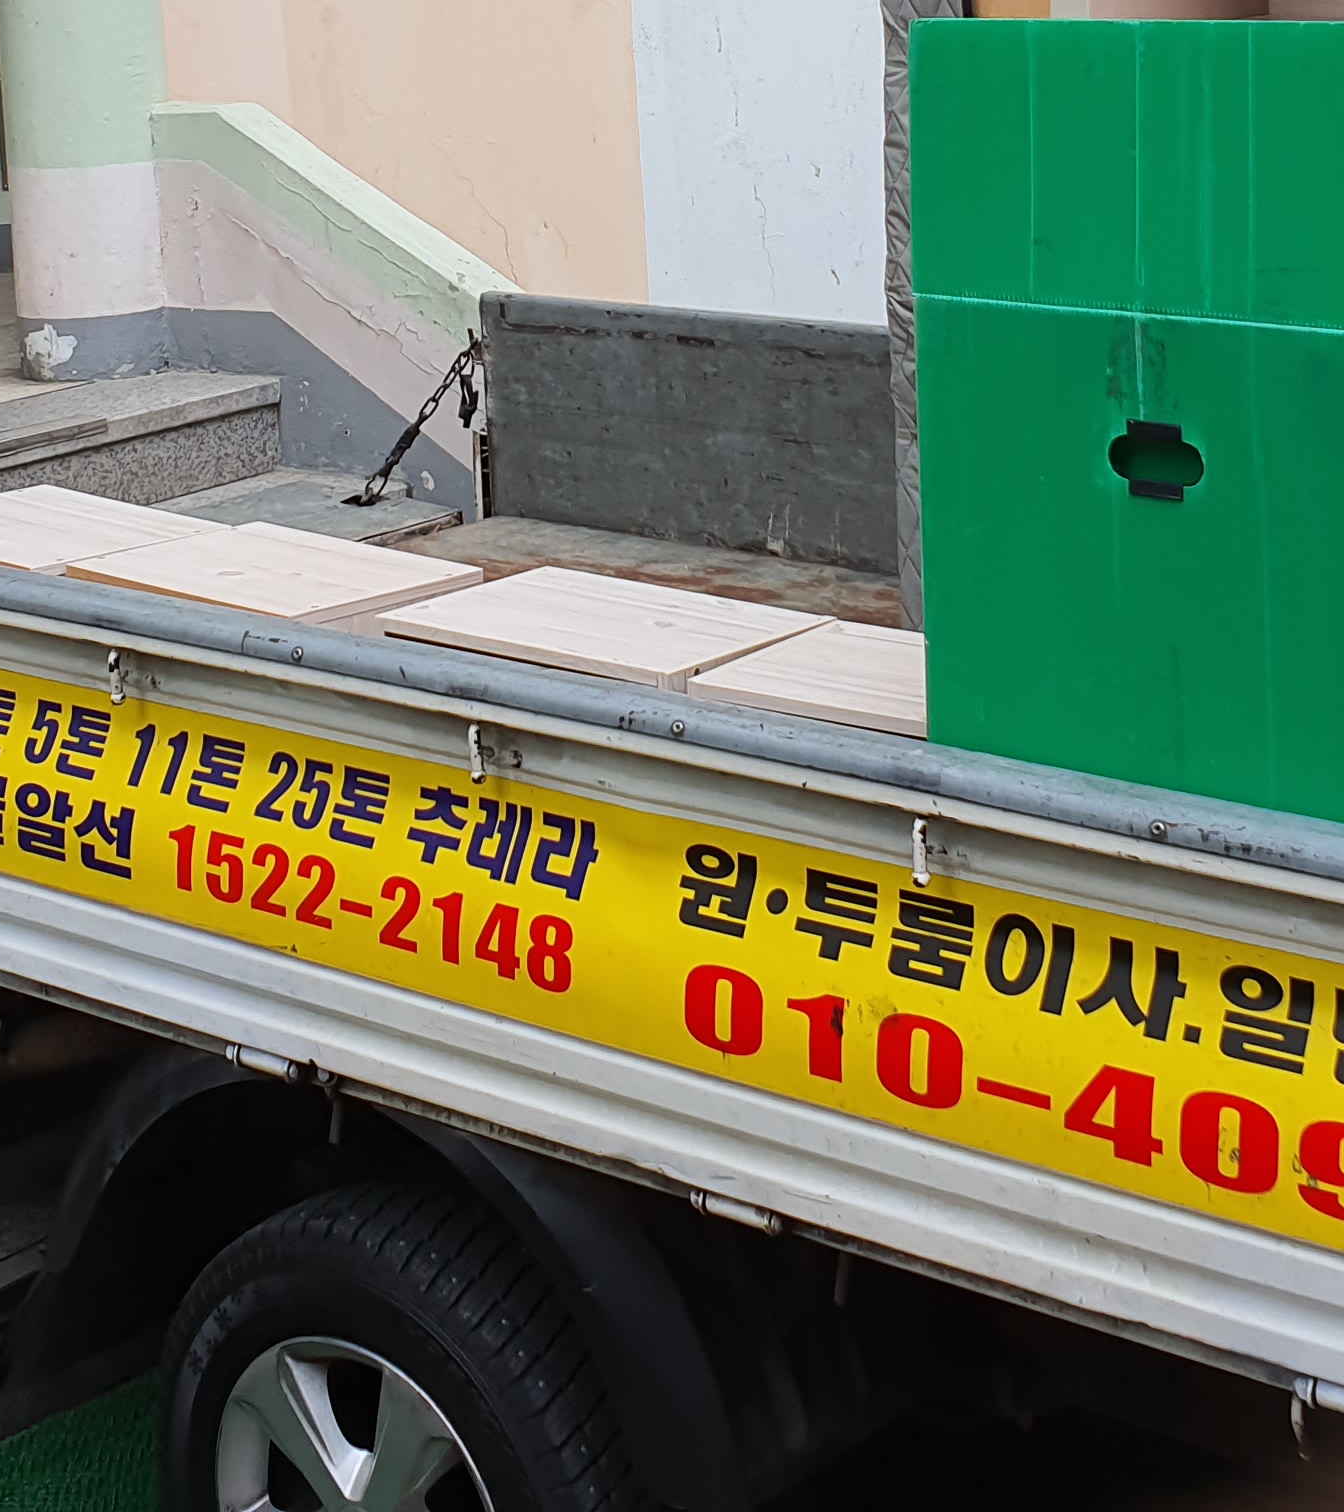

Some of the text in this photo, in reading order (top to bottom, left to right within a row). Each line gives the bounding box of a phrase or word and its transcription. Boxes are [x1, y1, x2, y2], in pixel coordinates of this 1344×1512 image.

[24, 699, 112, 781] 5톤
[127, 723, 246, 813] 11톤
[254, 751, 391, 849] 25톤
[407, 786, 600, 902] 추레라
[168, 824, 574, 994] 1522-2148
